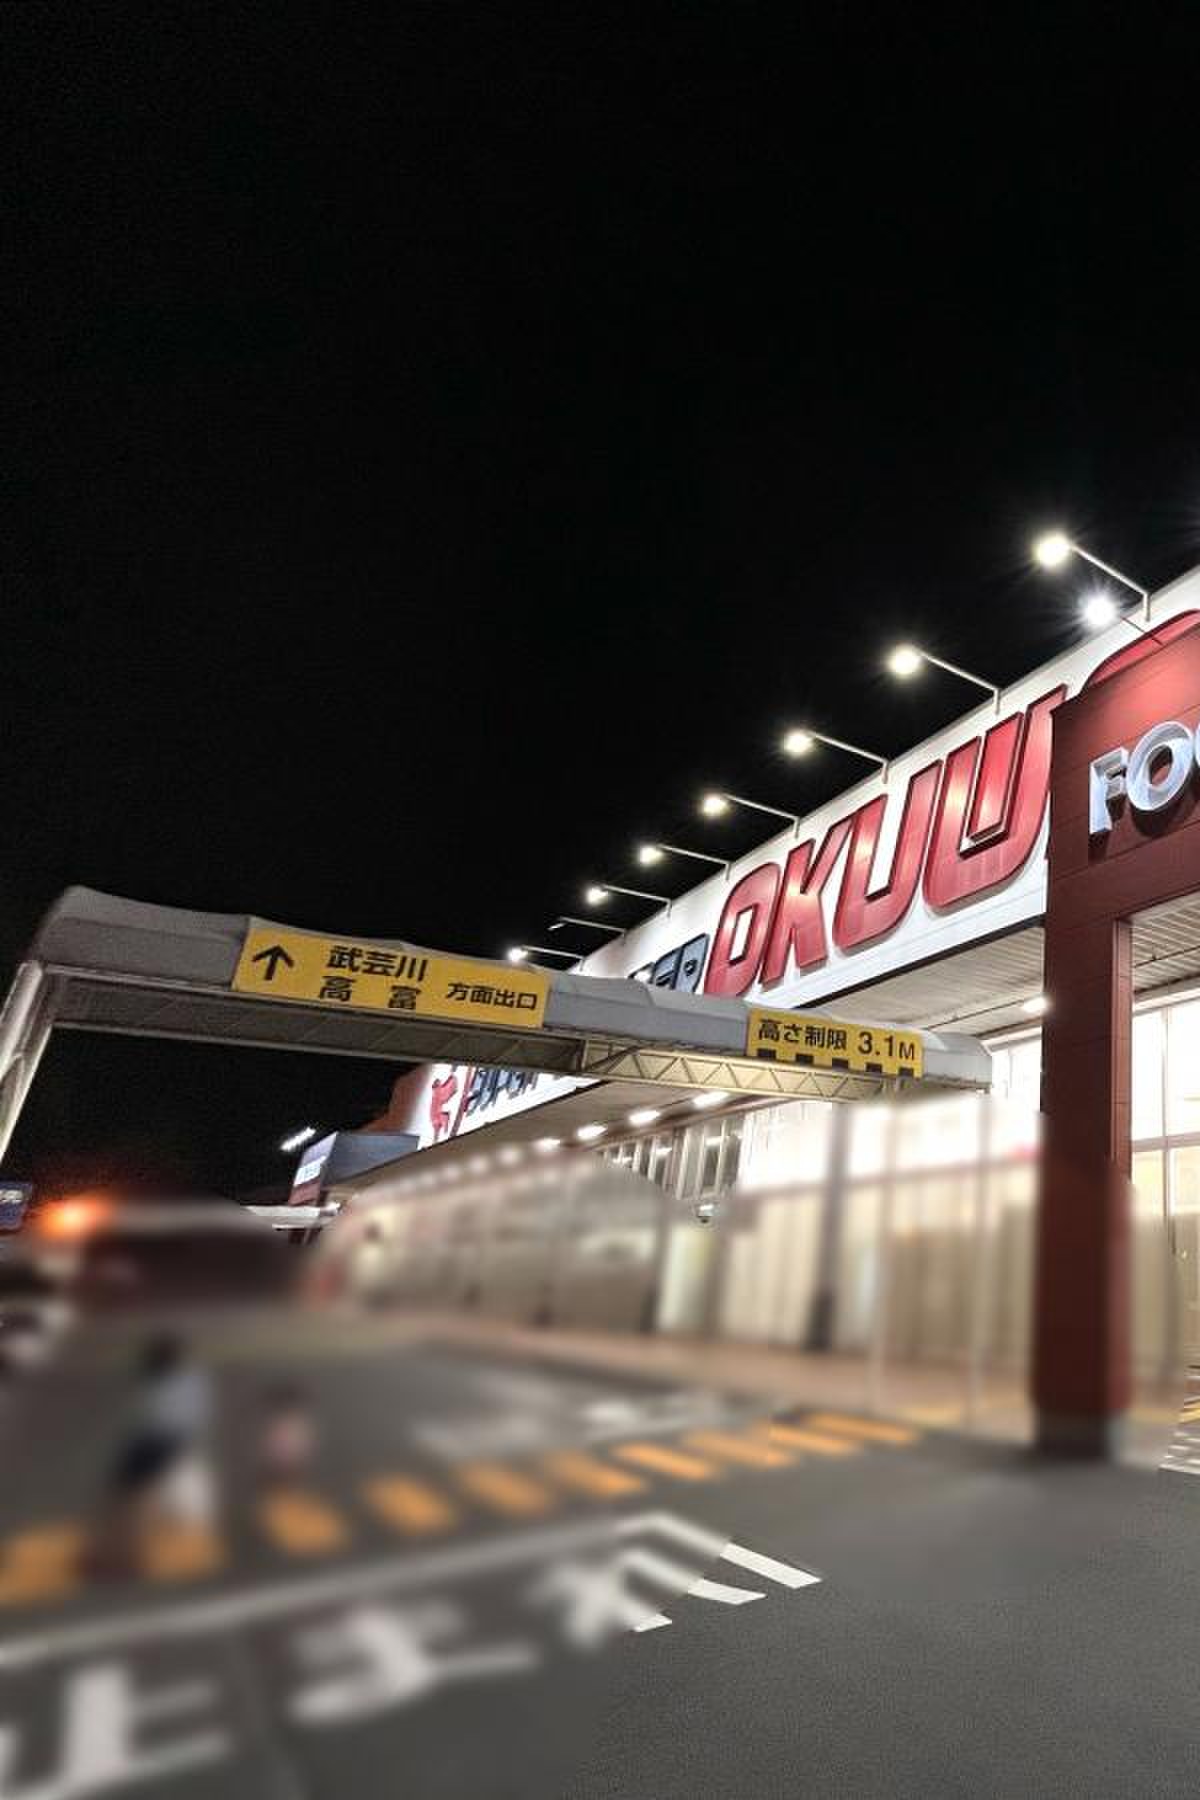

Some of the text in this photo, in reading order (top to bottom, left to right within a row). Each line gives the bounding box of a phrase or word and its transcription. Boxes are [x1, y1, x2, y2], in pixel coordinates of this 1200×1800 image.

[326, 945, 428, 982] 武芸川
[446, 982, 538, 1011] 方面出口
[758, 1019, 915, 1060] 高さ制限 3.1M
